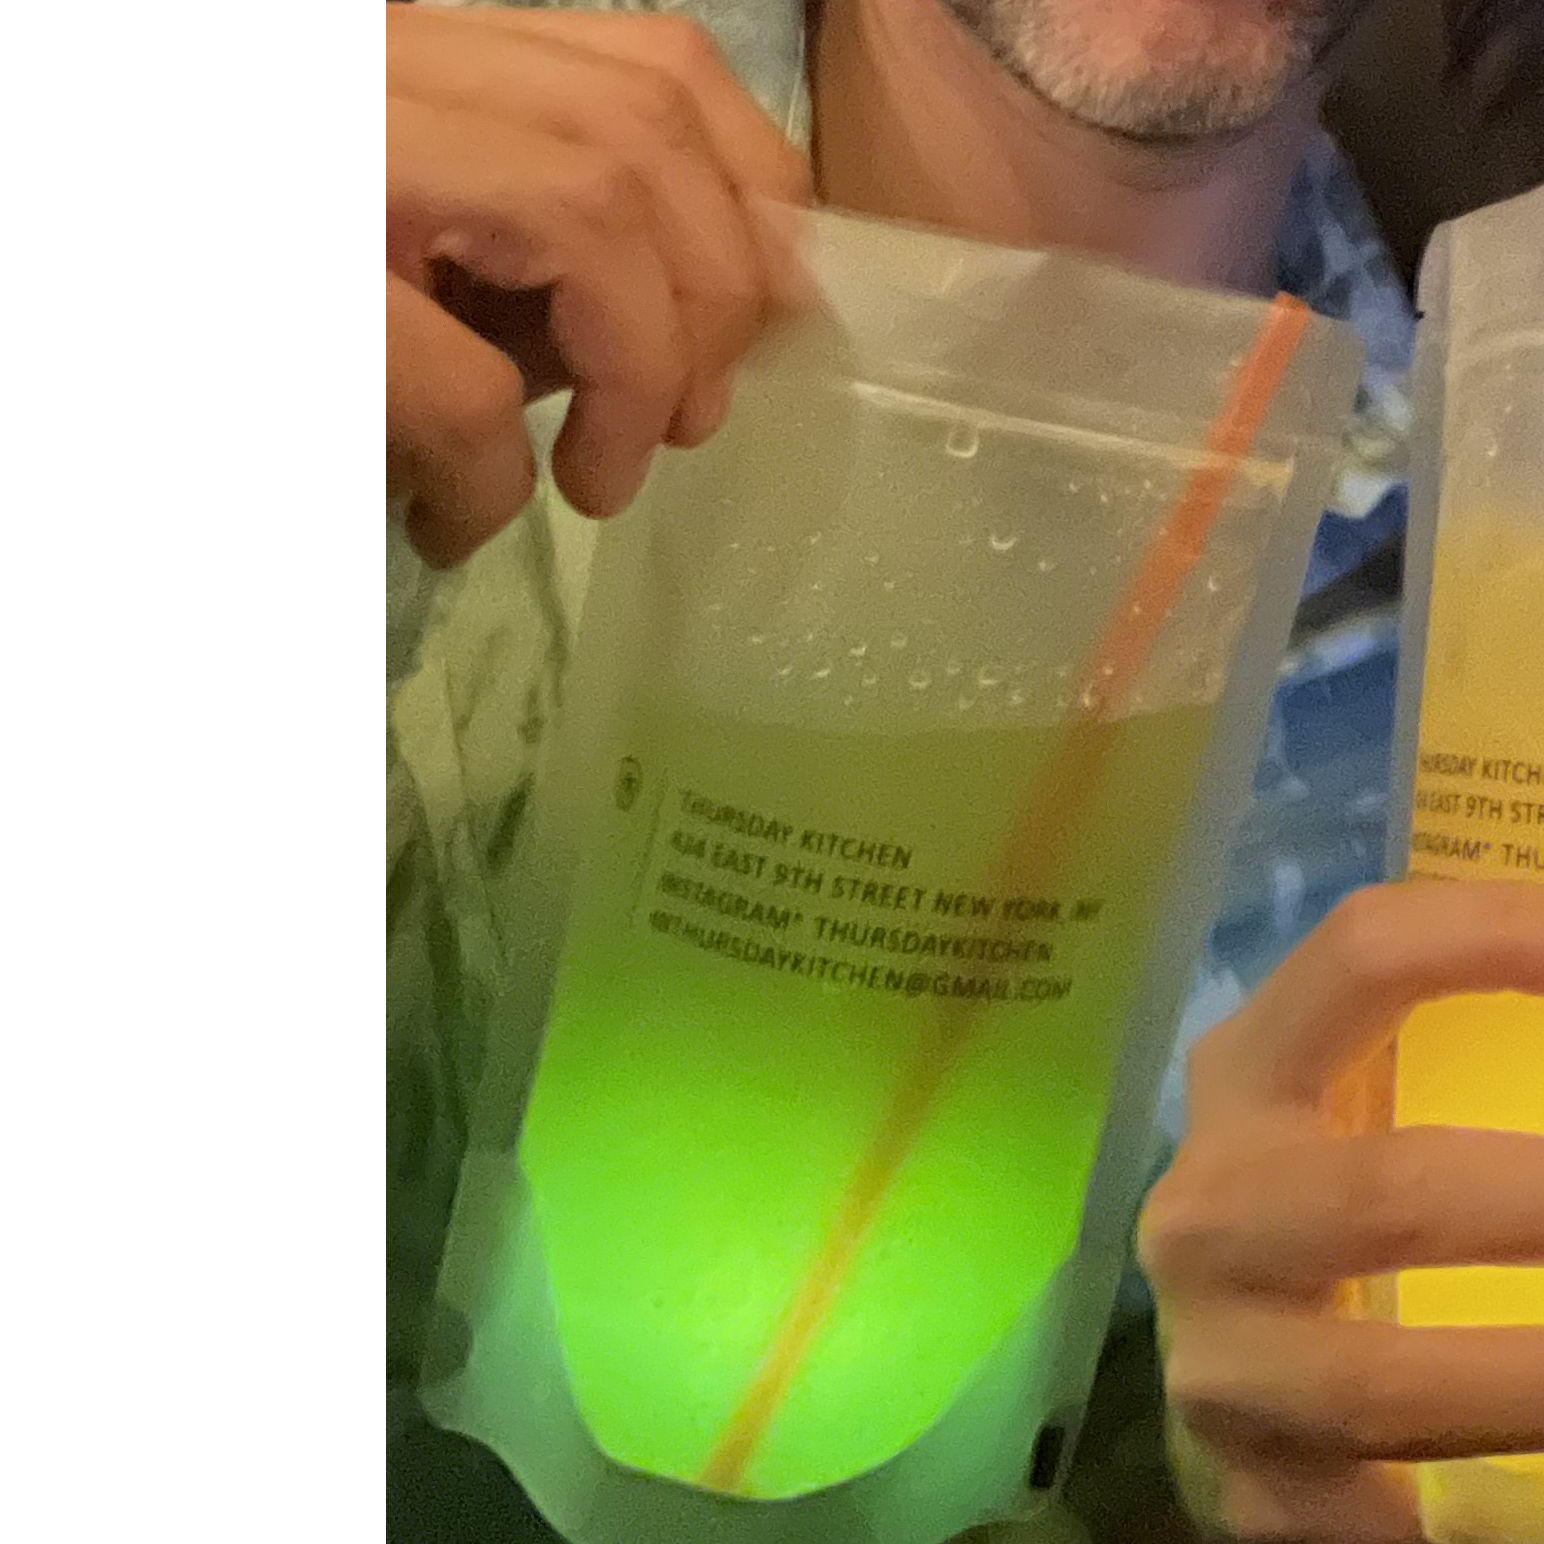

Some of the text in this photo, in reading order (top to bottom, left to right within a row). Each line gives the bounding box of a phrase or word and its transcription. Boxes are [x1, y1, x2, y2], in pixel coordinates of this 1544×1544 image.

[1465, 795, 1503, 820] 9TH
[800, 829, 912, 870] KITCHEN
[711, 841, 766, 879] EAST
[773, 859, 825, 894] 9TH
[831, 874, 927, 912] STREET
[932, 888, 997, 918] NEW
[812, 915, 1054, 962] THURSDAYKITCHEN
